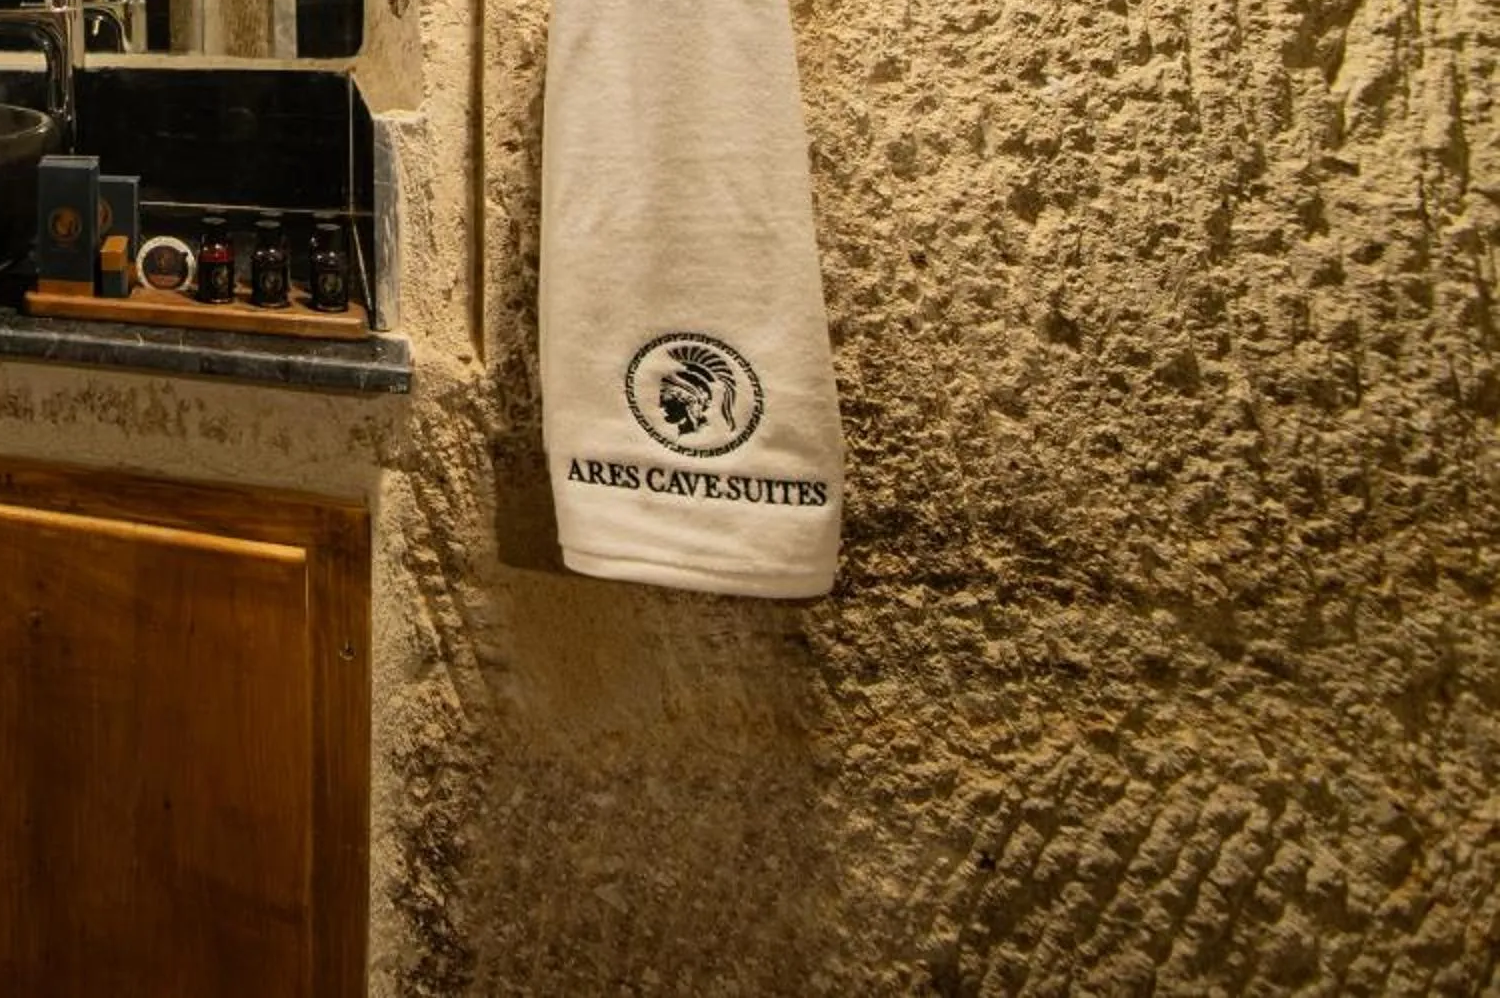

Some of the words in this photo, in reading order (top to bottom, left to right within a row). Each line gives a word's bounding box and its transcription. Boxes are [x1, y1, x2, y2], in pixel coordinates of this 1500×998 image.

[568, 458, 641, 490] ARES
[646, 467, 722, 500] CAVE
[726, 476, 828, 507] SUITES
